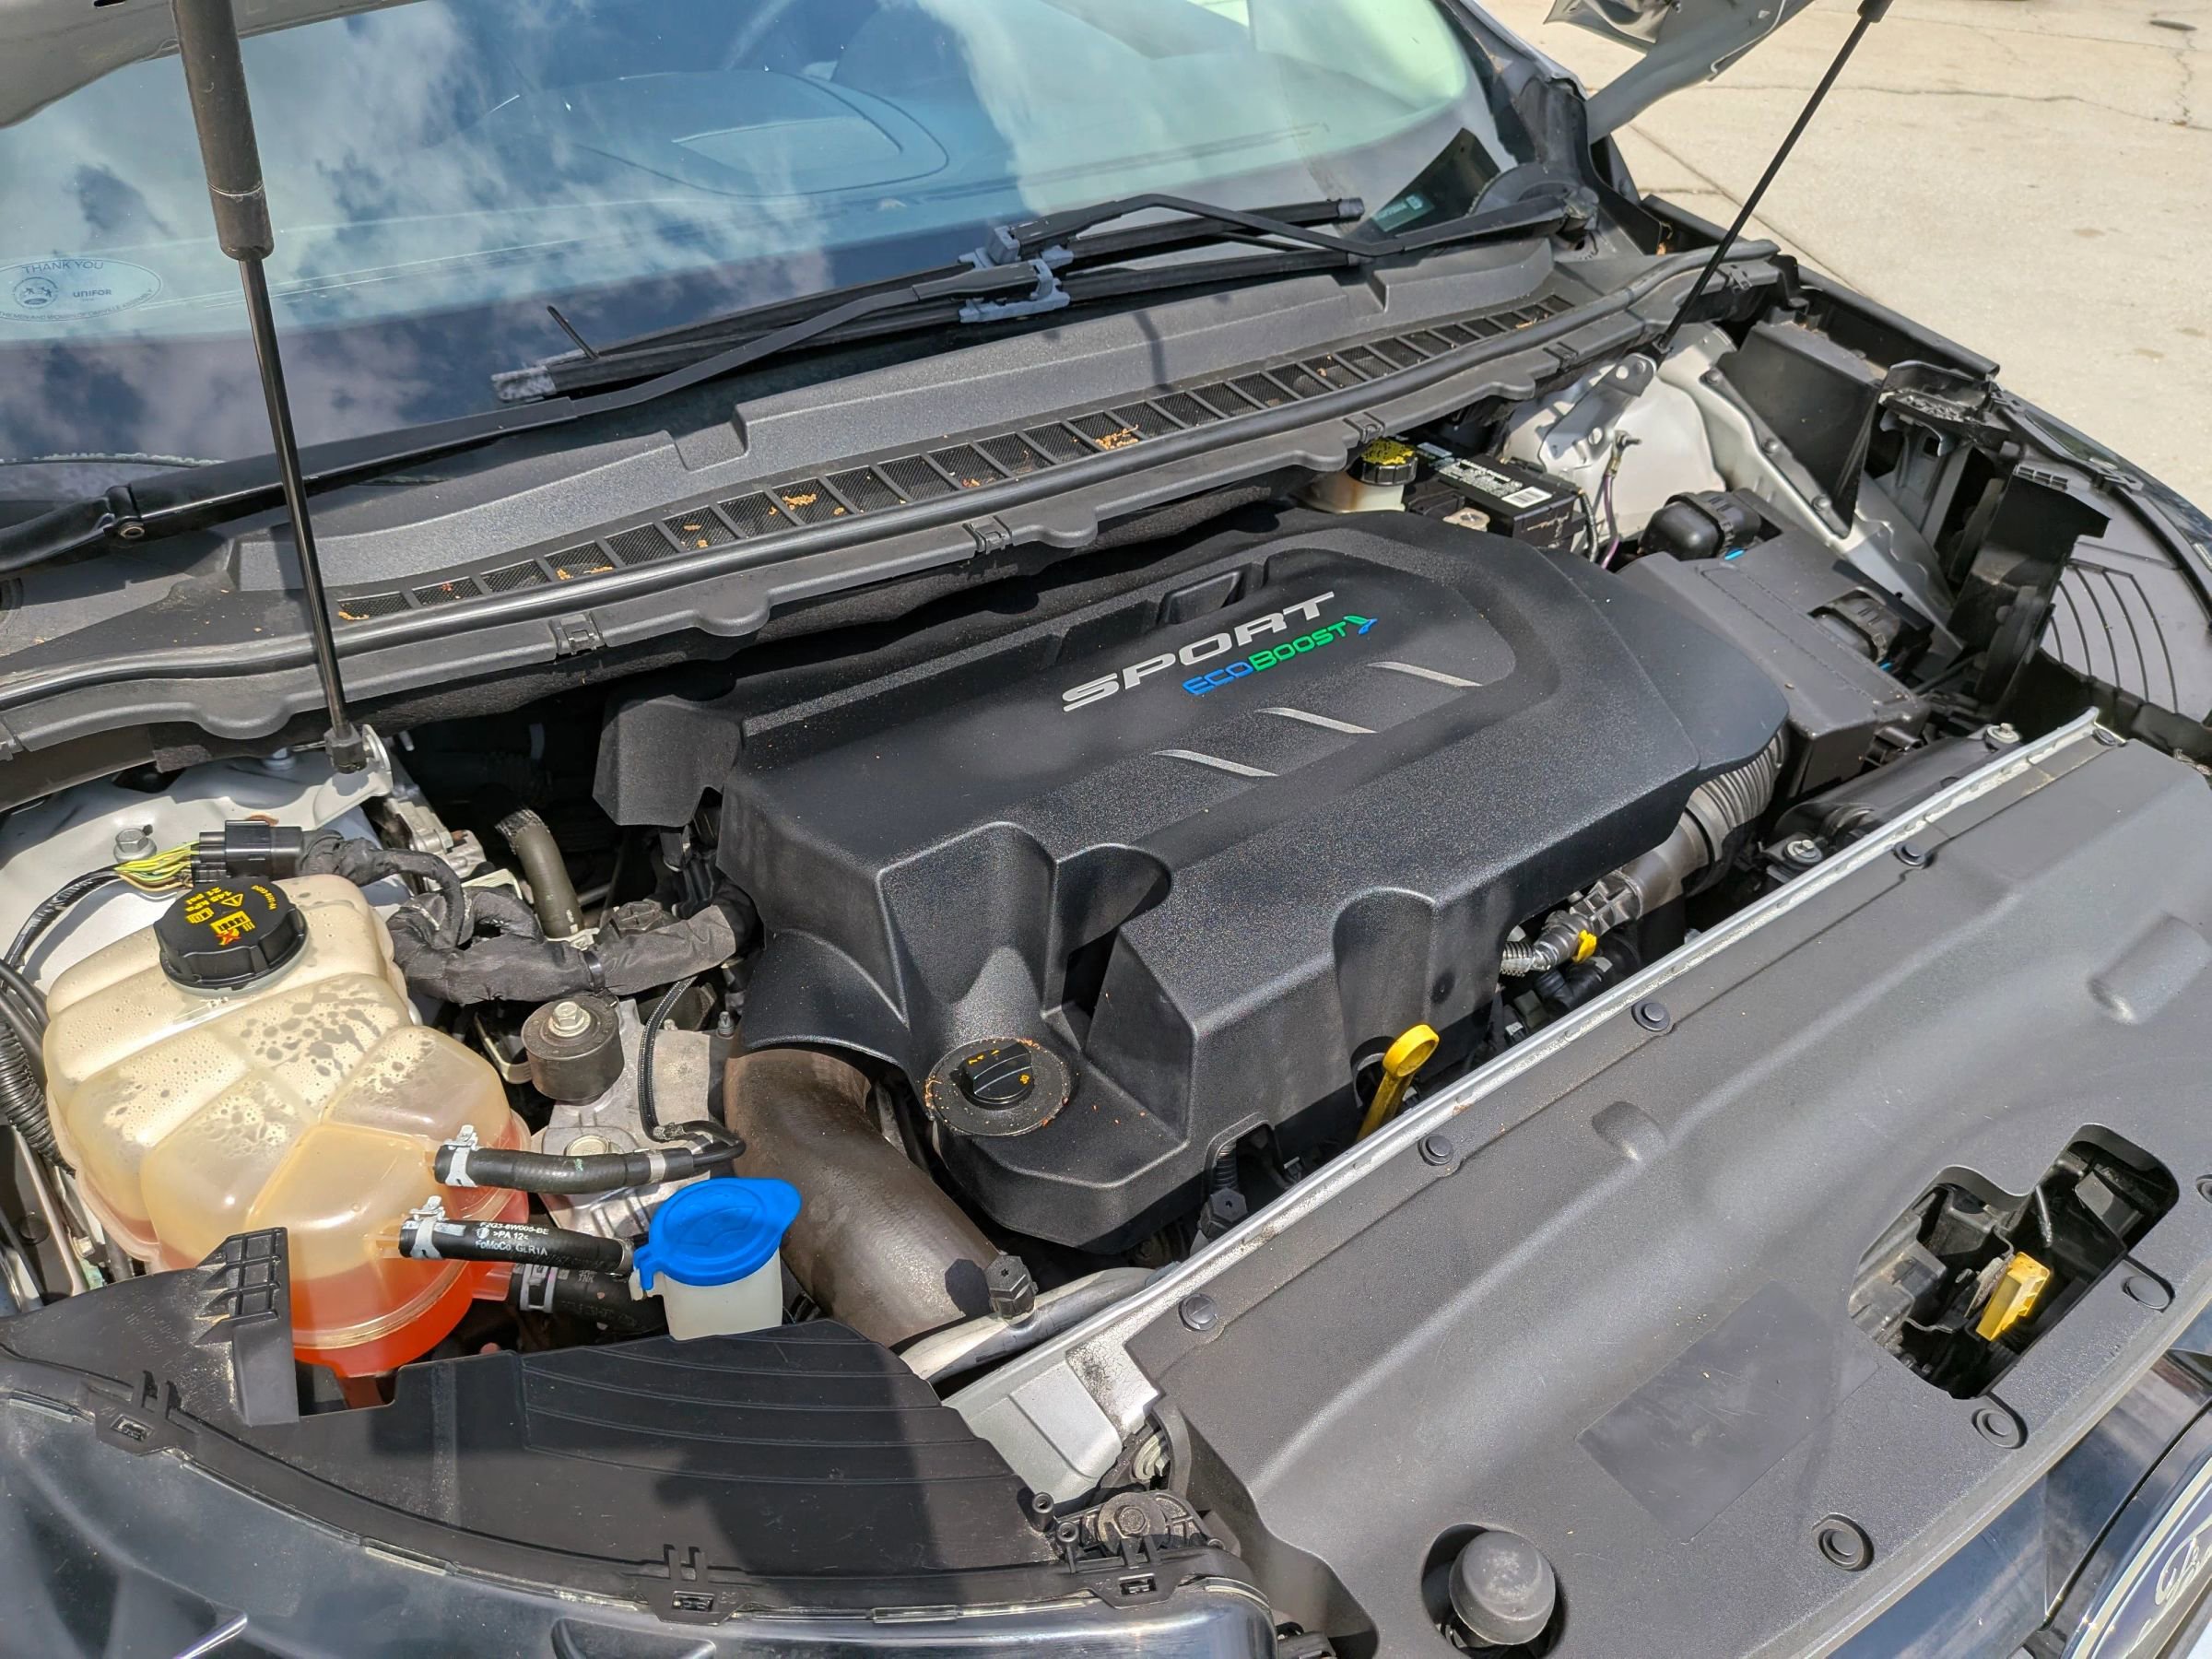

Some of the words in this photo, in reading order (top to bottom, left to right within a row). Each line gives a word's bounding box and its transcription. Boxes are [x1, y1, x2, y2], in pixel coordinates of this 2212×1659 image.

[21, 261, 71, 275] THANK
[74, 260, 104, 270] YOU
[1062, 591, 1335, 712] SPORT
